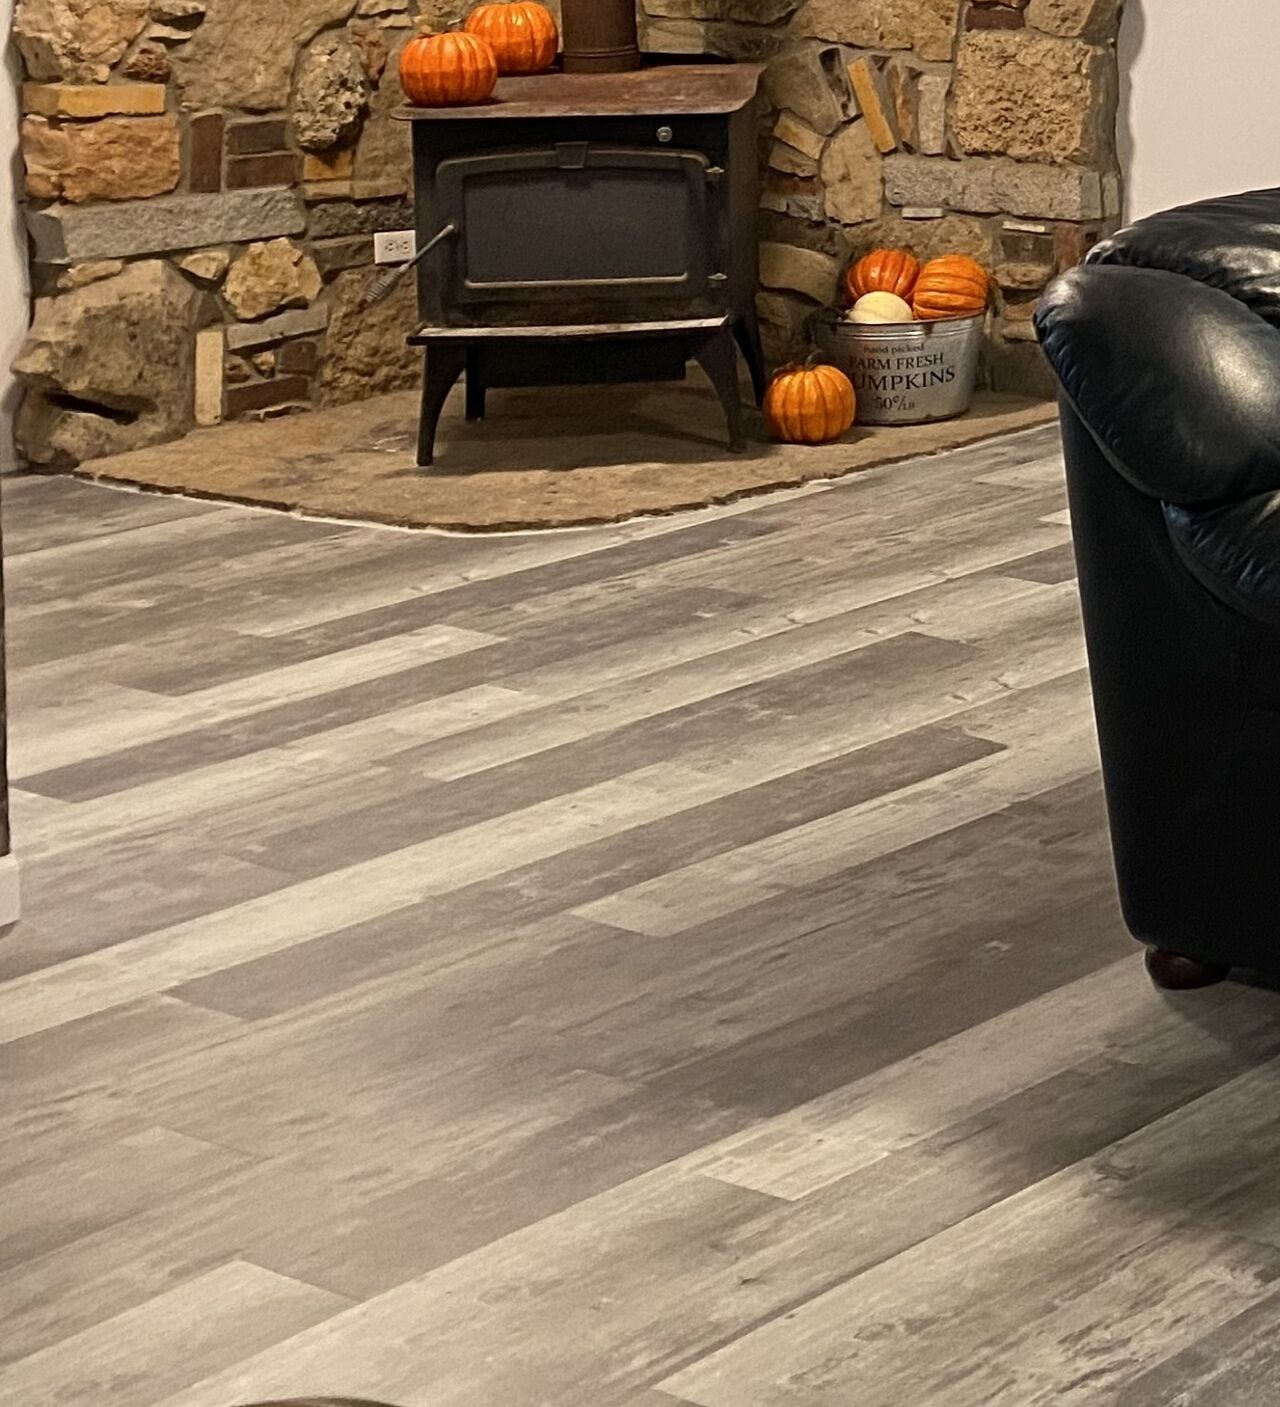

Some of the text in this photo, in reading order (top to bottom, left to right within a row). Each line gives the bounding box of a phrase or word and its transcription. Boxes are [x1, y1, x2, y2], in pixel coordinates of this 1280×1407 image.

[849, 352, 944, 370] FARM FRESH
[851, 365, 956, 390] UMPKINS
